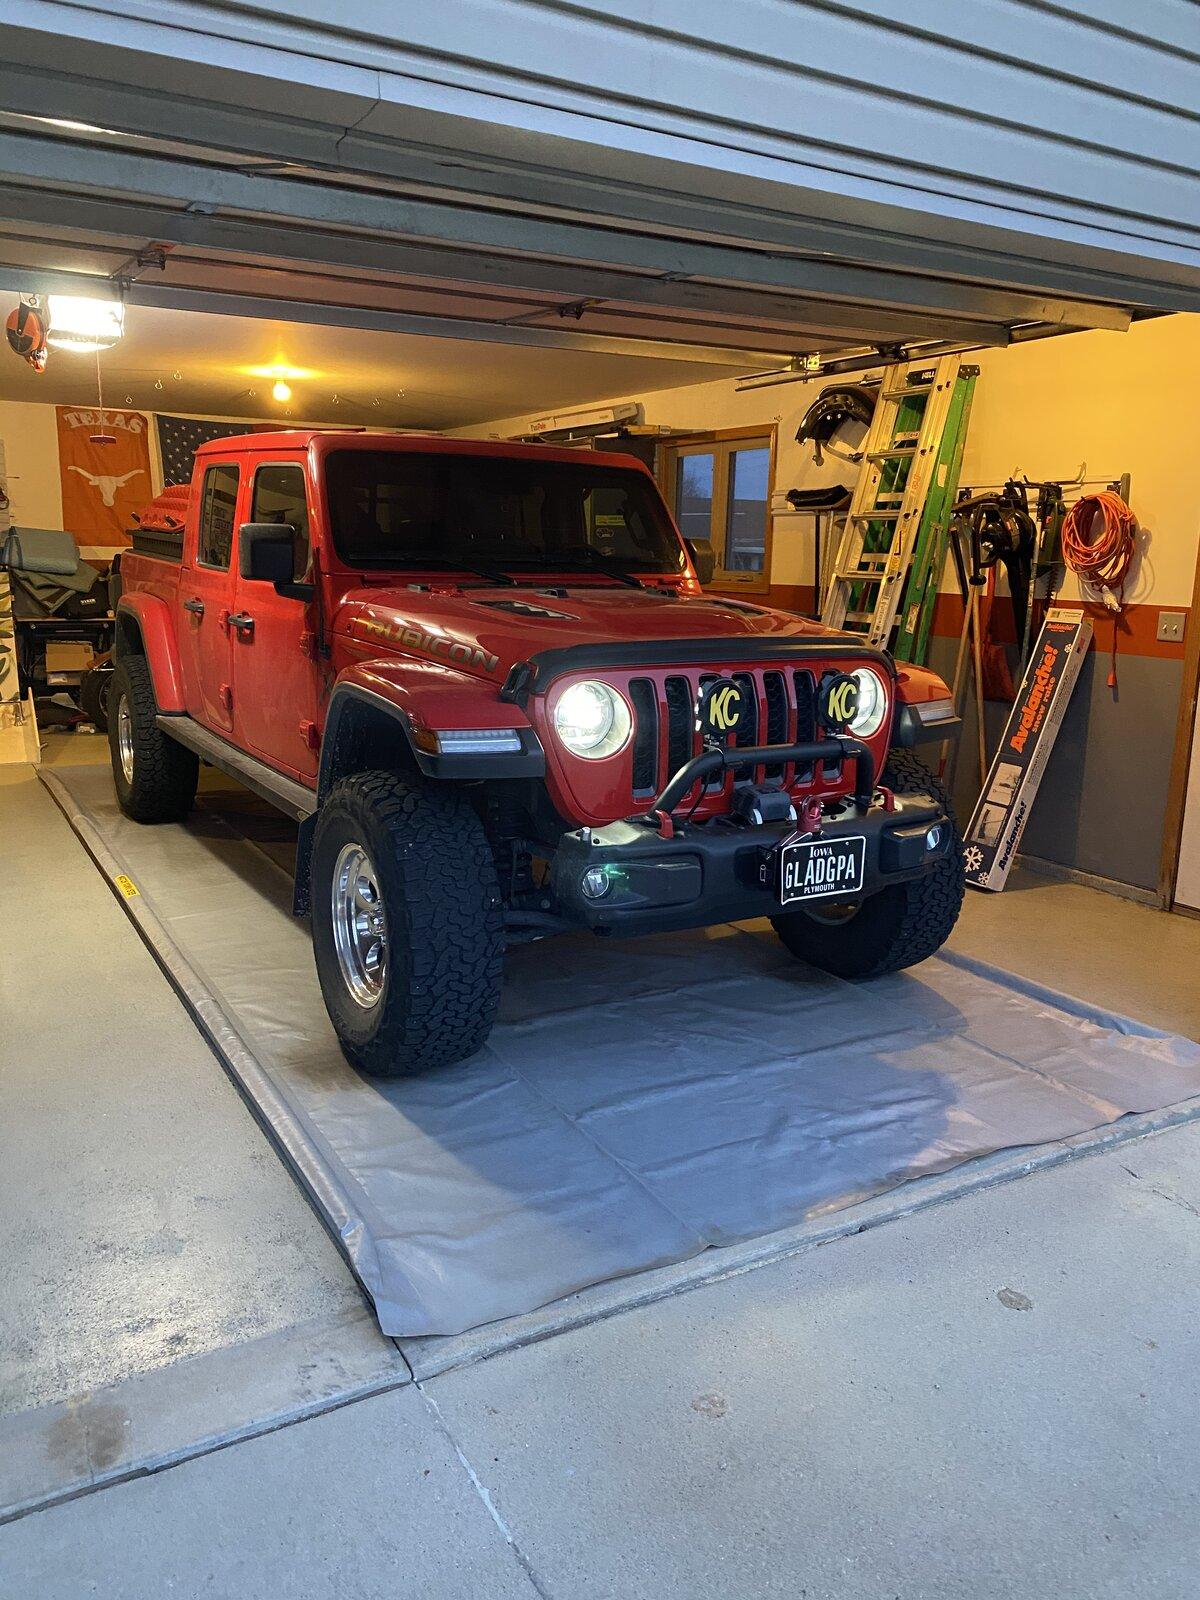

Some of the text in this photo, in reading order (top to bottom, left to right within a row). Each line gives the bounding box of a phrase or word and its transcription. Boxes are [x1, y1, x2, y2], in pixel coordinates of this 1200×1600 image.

[63, 411, 144, 434] TEXAS
[366, 620, 500, 673] RUBICON
[709, 686, 741, 730] KC
[827, 681, 858, 722] KC
[1009, 643, 1059, 754] Avalanche!
[1031, 704, 1046, 733] snow
[1042, 676, 1056, 703] rake
[785, 853, 855, 889] GLADGPA
[803, 883, 835, 894] PLYMOUTH
